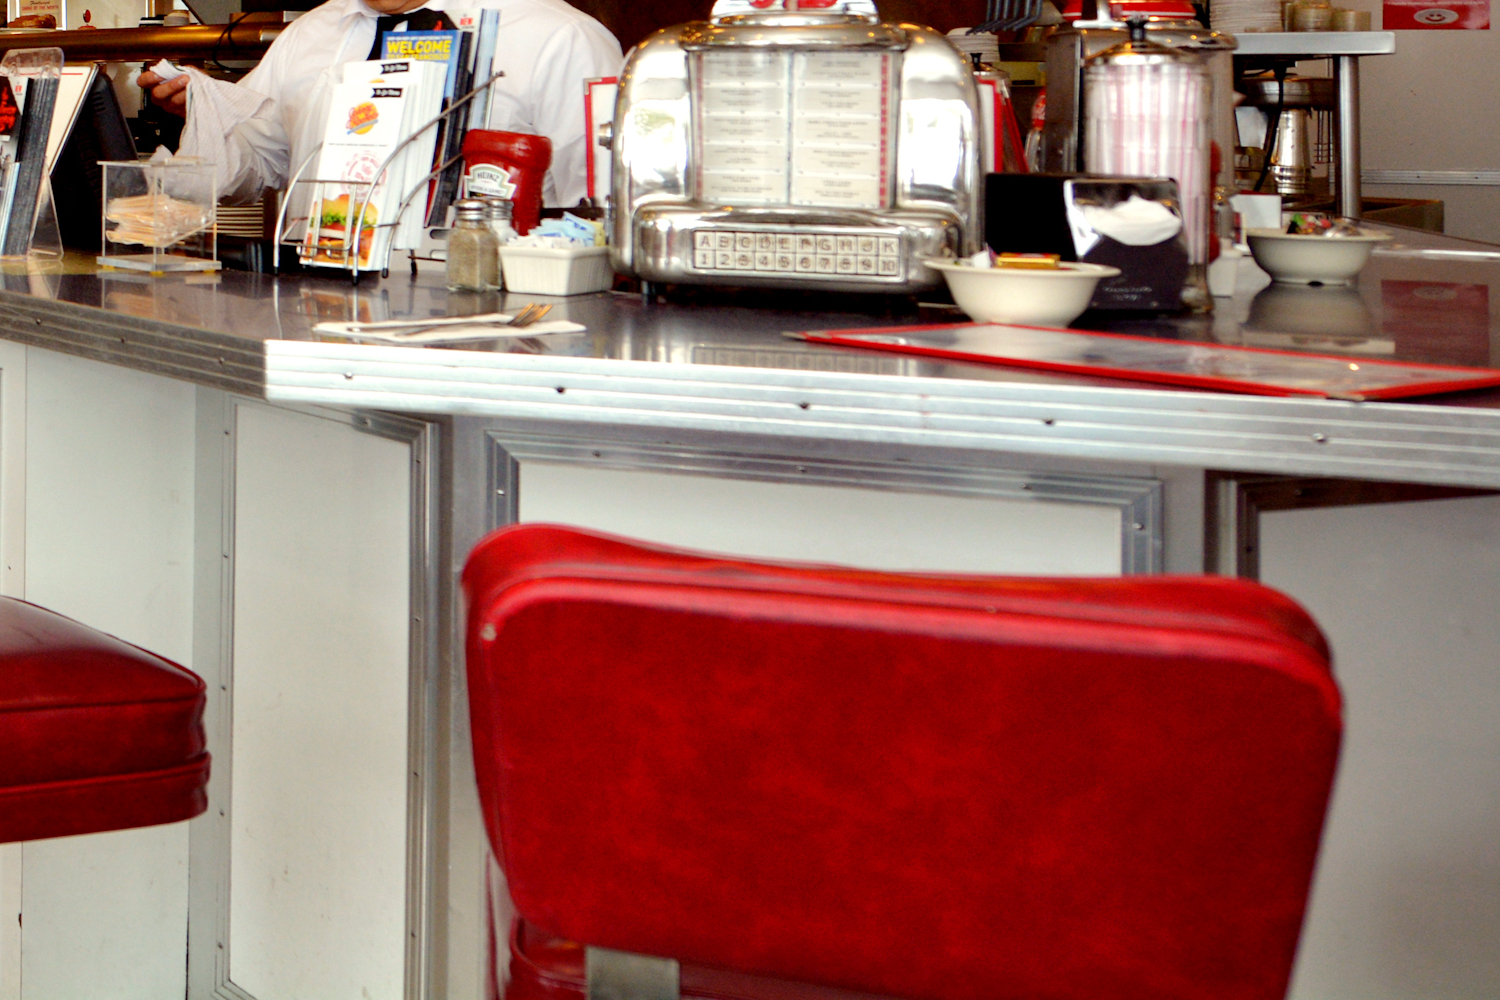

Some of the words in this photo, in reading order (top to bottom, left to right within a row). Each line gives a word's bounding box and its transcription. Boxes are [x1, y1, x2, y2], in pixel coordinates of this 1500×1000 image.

[387, 40, 452, 53] WELCOME
[477, 171, 500, 182] HEINZ
[701, 235, 710, 247] A
[819, 239, 831, 250] G
[884, 241, 894, 252] K
[702, 254, 708, 265] 1
[721, 255, 729, 265] 2
[760, 256, 768, 266] 4
[882, 260, 895, 271] 10
